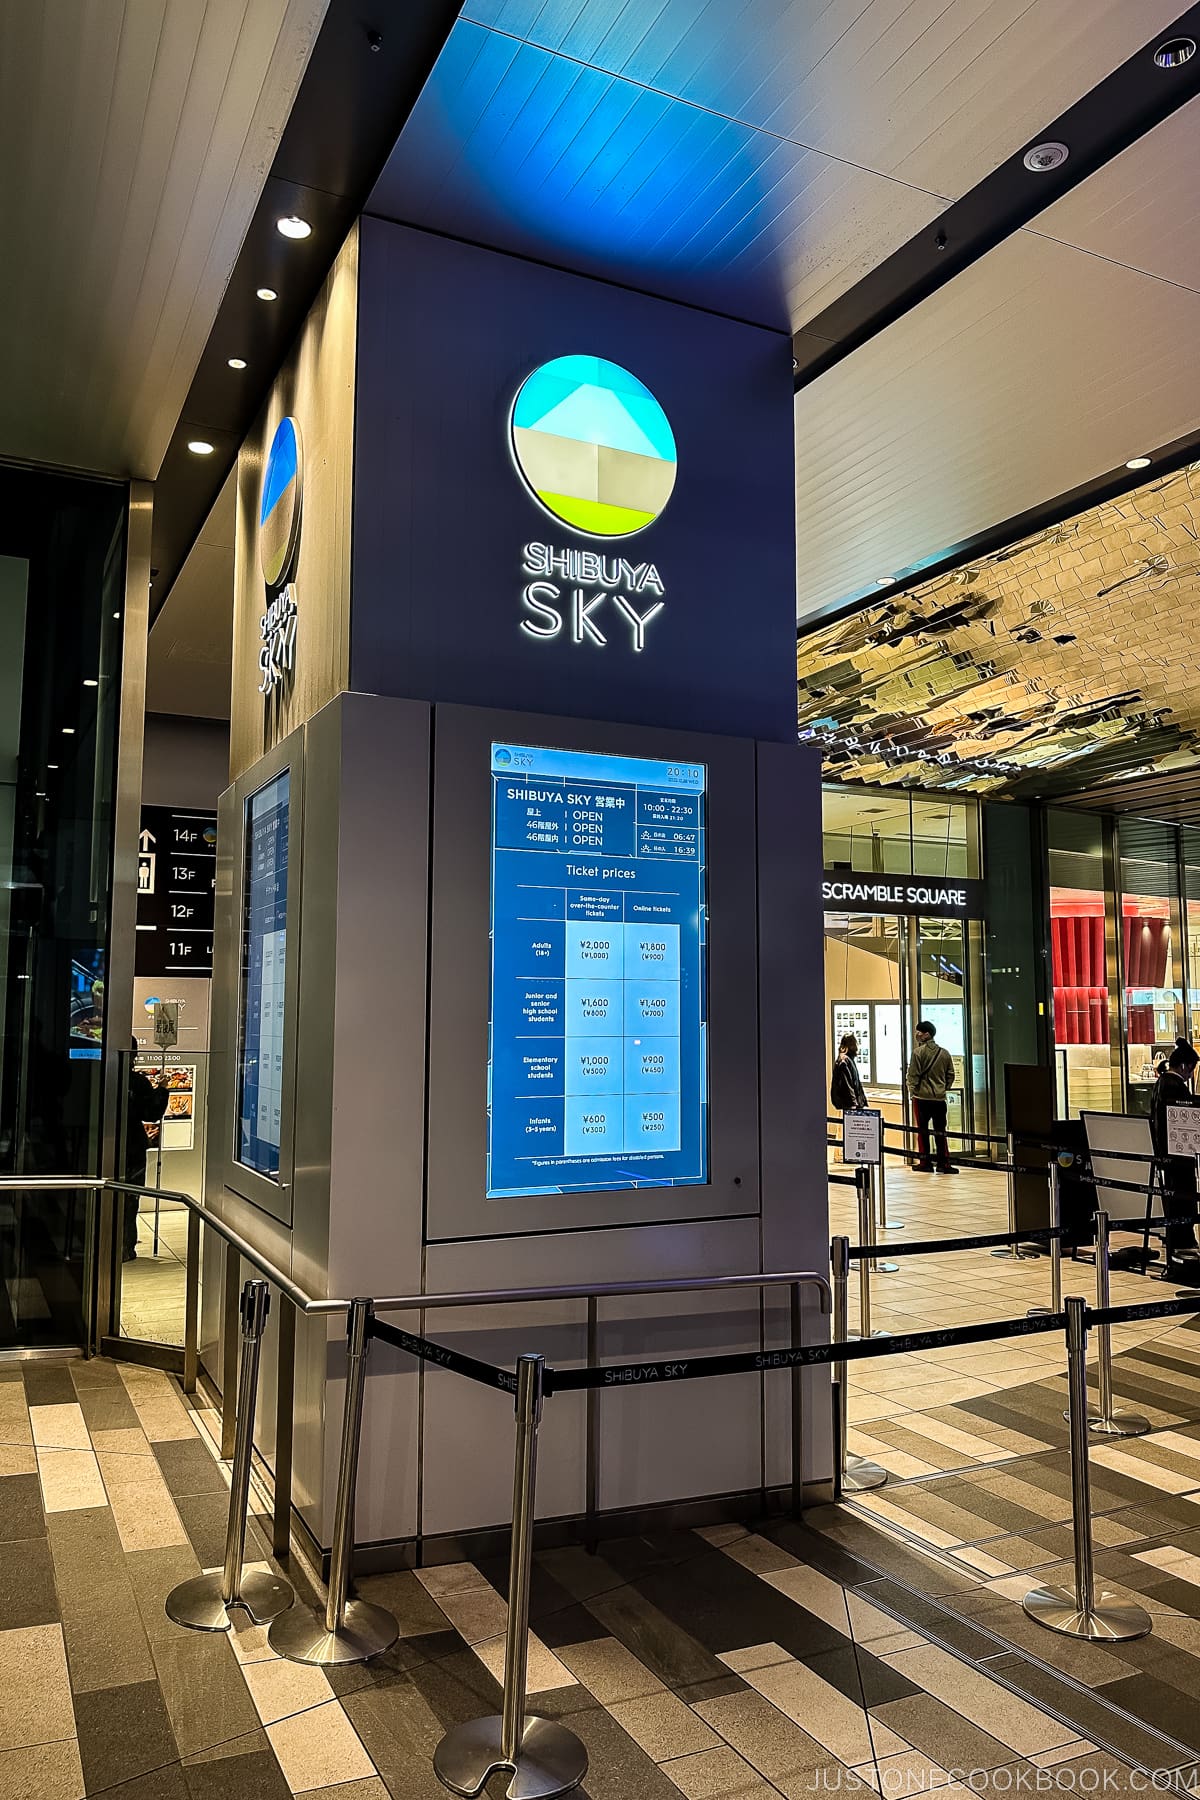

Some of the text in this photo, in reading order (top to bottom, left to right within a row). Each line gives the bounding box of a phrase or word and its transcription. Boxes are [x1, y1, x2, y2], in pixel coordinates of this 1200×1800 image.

[521, 541, 665, 595] SHIBUYA
[520, 581, 665, 652] SKY
[513, 758, 534, 767] SKY
[507, 788, 626, 809] SHIBUYA SKY 営業中
[643, 803, 665, 812] 10:00
[671, 806, 693, 815] 22:30
[572, 810, 603, 822] OPEN
[572, 822, 603, 834] OPEN
[173, 828, 198, 843] 14F
[572, 835, 603, 846] OPEN
[673, 833, 696, 841] 06:47
[674, 846, 696, 854] 16:39
[171, 867, 196, 881] 13F
[566, 864, 636, 880] Ticket prices
[579, 895, 610, 903] Same-day
[822, 882, 967, 906] SCRAMBLE SQUARE
[170, 904, 195, 919] 12F
[569, 903, 620, 911] over-the-counter
[169, 942, 192, 956] 11F
[580, 941, 610, 950] ¥2,000
[639, 942, 666, 952] ¥1,800
[581, 951, 609, 960] (¥1,000)
[641, 953, 664, 961] (¥900)
[580, 999, 609, 1008] ¥1,600
[639, 999, 666, 1008] ¥1,400
[523, 1008, 537, 1016] high
[580, 1056, 609, 1065] ¥1,000
[642, 1055, 664, 1064] ¥900
[583, 1114, 606, 1124] ¥600
[642, 1113, 664, 1122] ¥500
[641, 1123, 665, 1132] (¥250)
[937, 1333, 956, 1343] SKY
[755, 1348, 830, 1367] SHIBUYA SKY
[604, 1363, 689, 1384] SHIBUYA SKY
